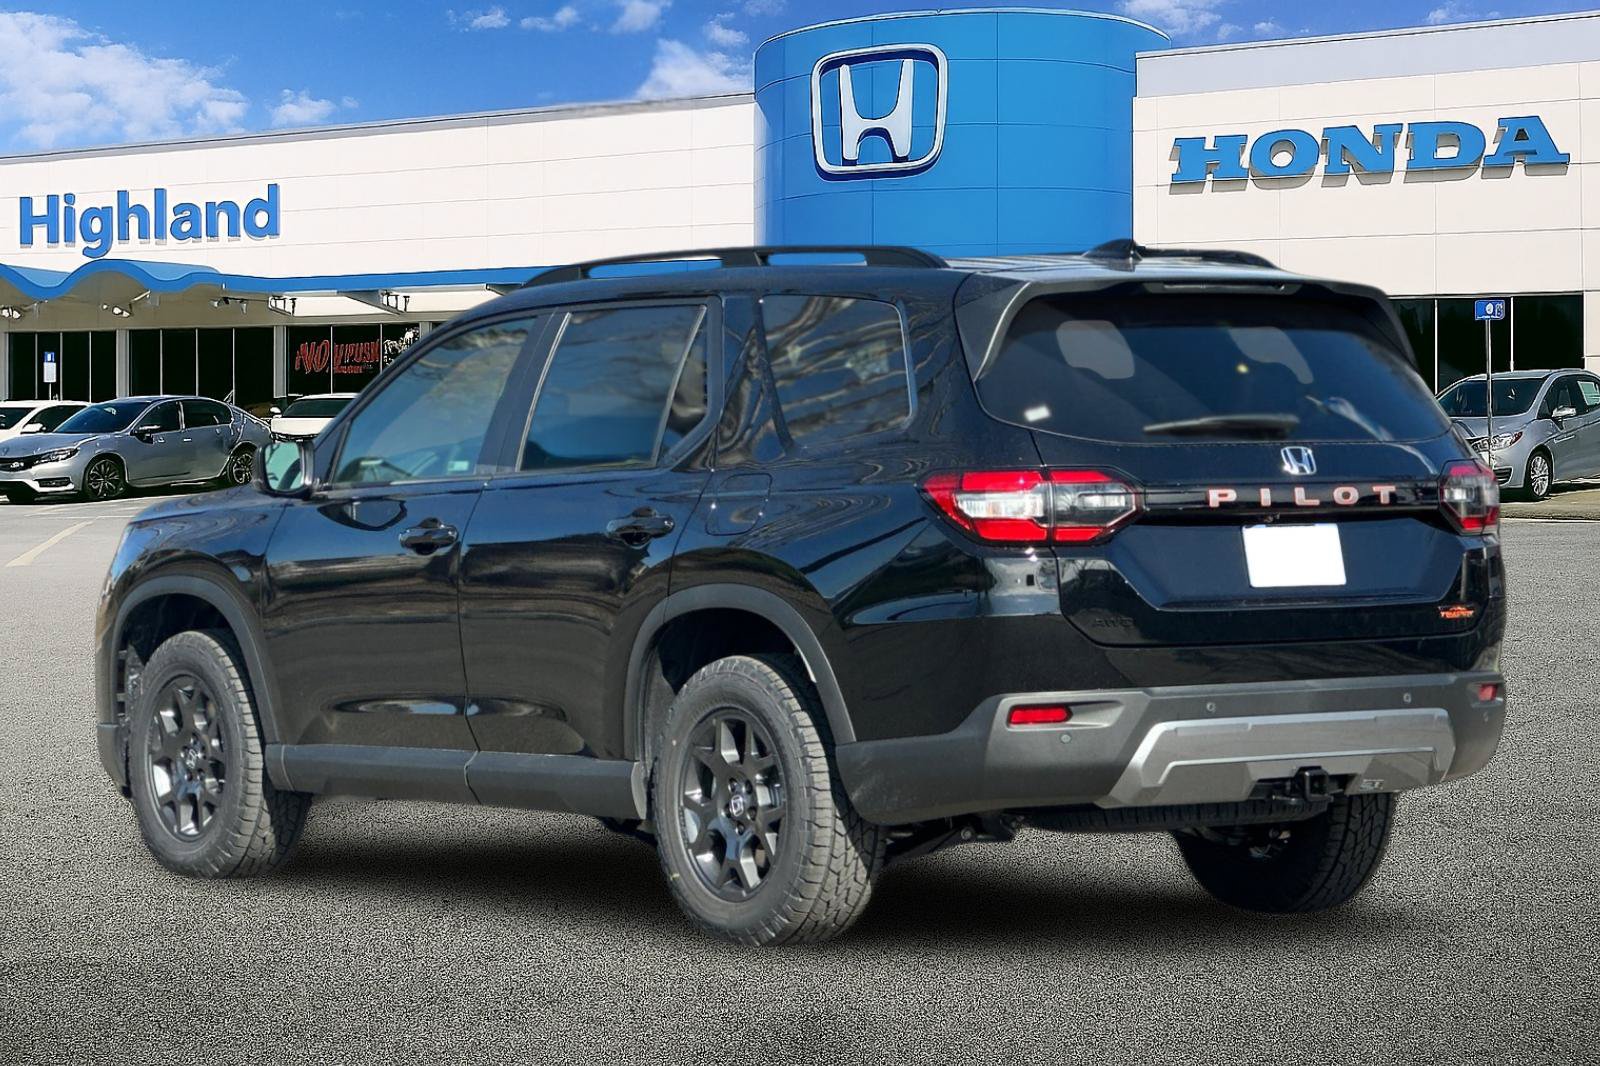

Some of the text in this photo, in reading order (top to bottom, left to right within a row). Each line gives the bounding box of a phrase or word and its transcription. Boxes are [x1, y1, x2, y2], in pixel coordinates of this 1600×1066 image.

[1170, 115, 1571, 184] HONDA
[19, 183, 281, 259] Highland
[1207, 485, 1397, 508] PILOT
